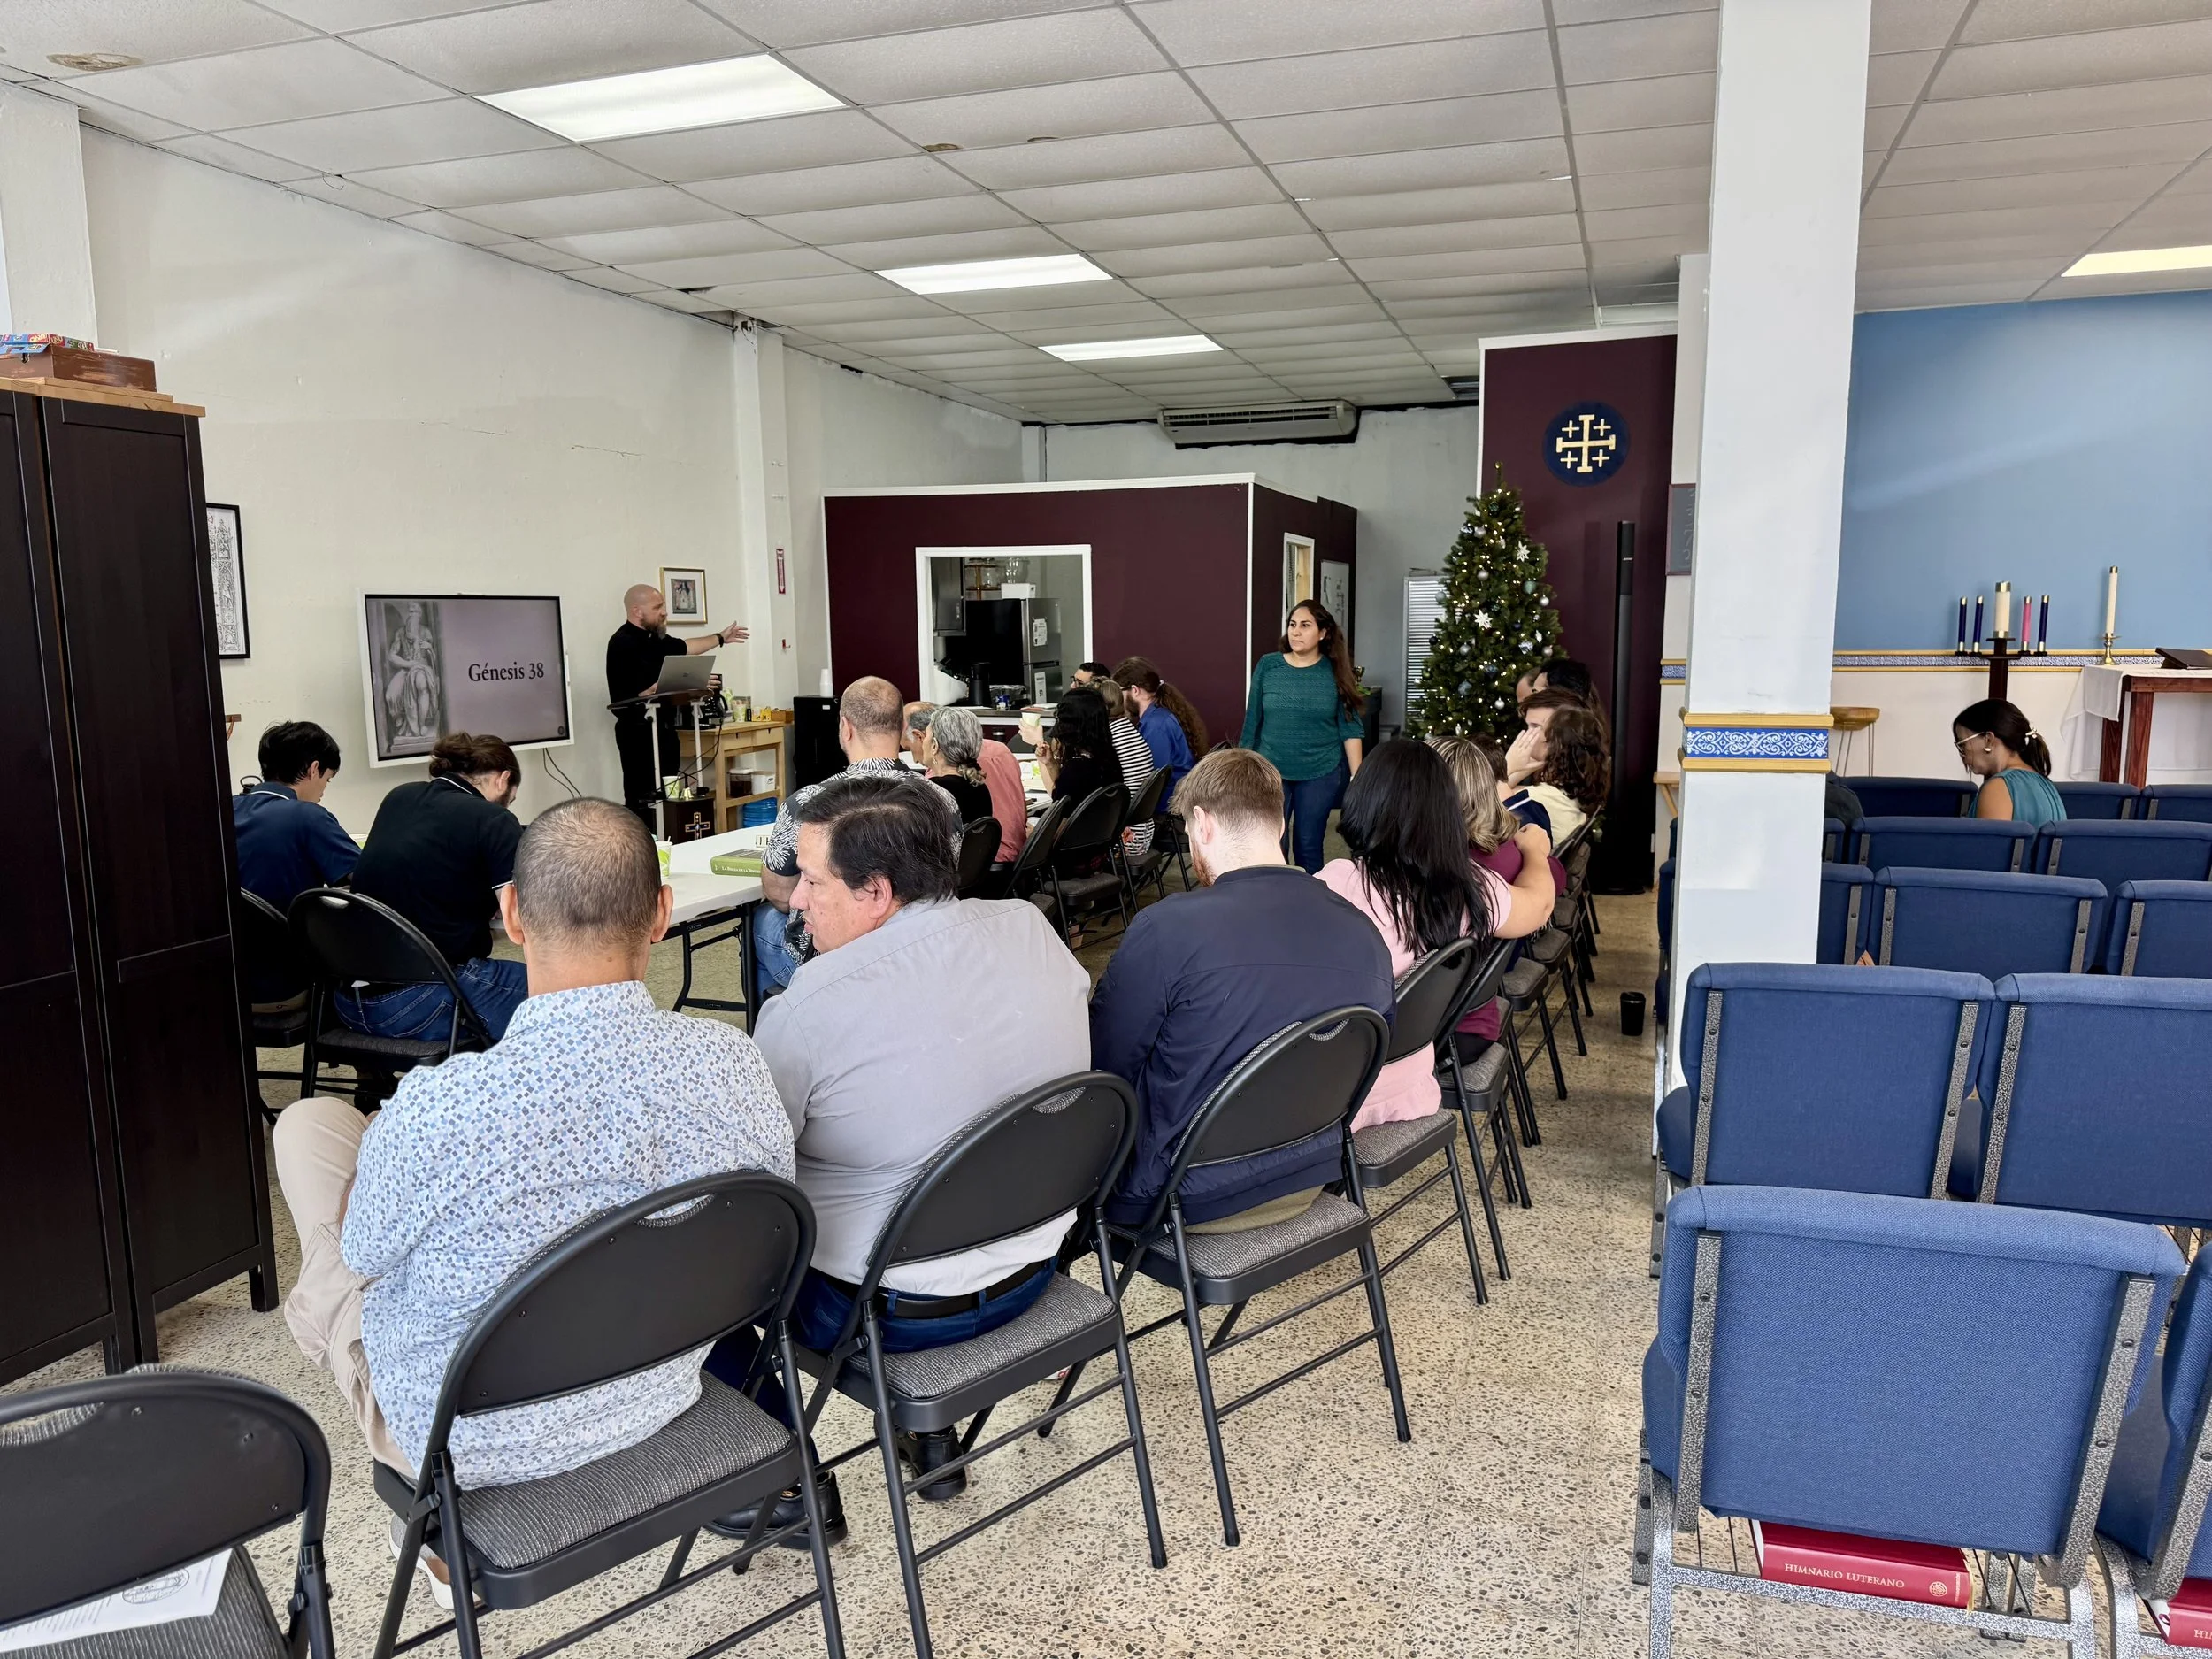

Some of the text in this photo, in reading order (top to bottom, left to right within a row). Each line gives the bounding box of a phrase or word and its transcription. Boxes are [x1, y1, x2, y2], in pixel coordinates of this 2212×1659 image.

[468, 661, 544, 682] Génesis 38
[1785, 1563, 1905, 1588] HIMNARIO LUTERANO
